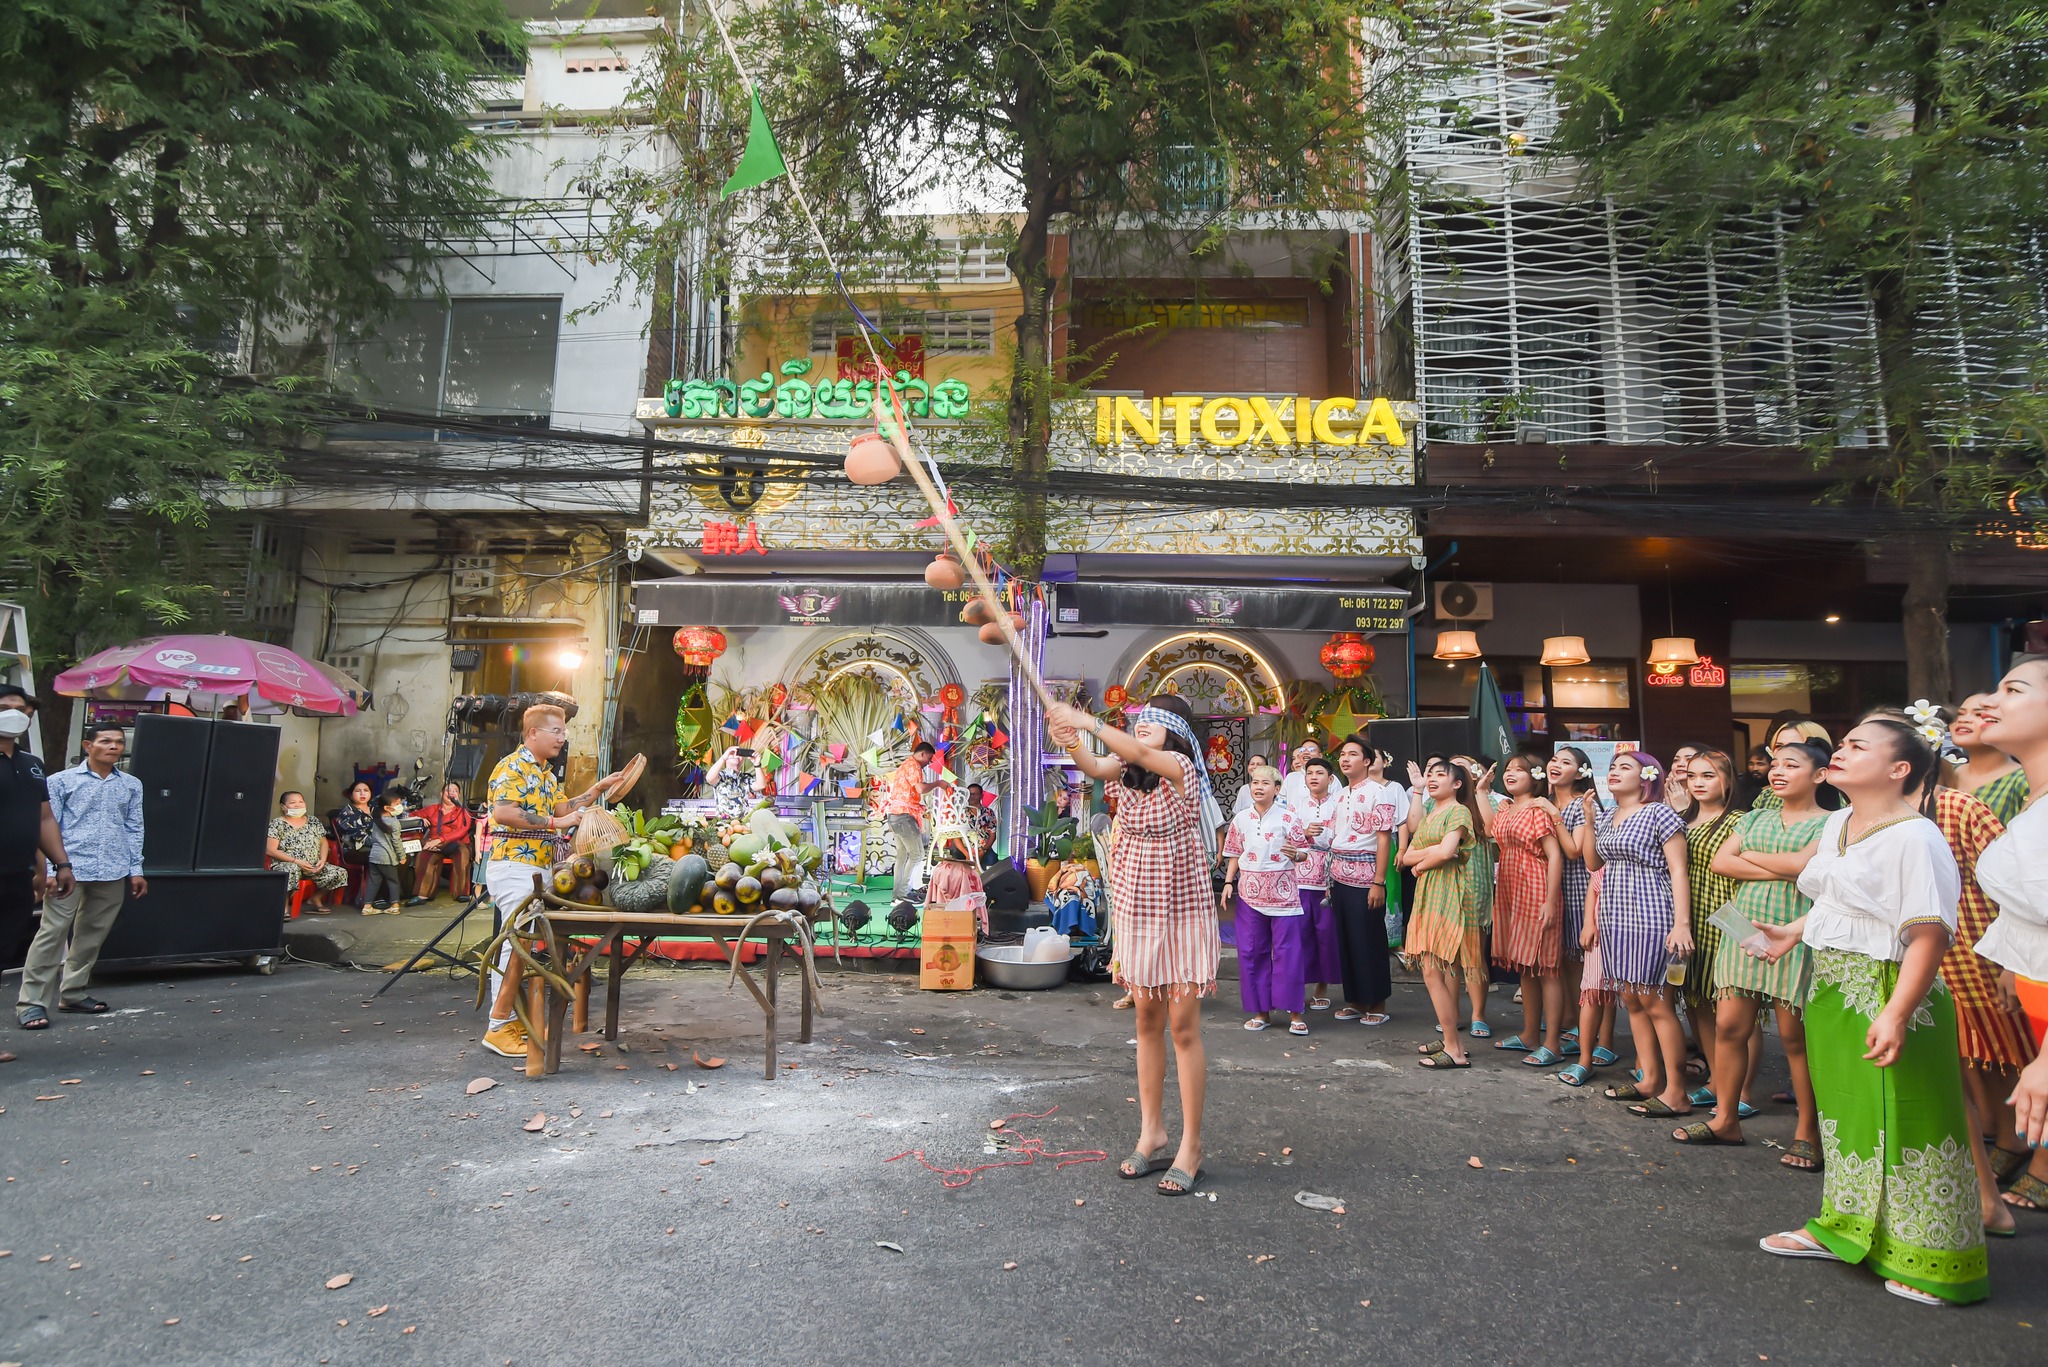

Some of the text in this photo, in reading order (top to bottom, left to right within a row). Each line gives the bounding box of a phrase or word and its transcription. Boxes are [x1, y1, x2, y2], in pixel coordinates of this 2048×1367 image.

[1096, 396, 1406, 446] INTOXICA
[702, 520, 768, 556] 醉人
[942, 591, 957, 602] Tel:
[1339, 597, 1404, 610] Tel: 061 722 297
[1356, 617, 1404, 629] 093 722 297
[160, 652, 194, 662] yes
[1647, 674, 1684, 685] Coffee
[1694, 671, 1721, 683] BAR
